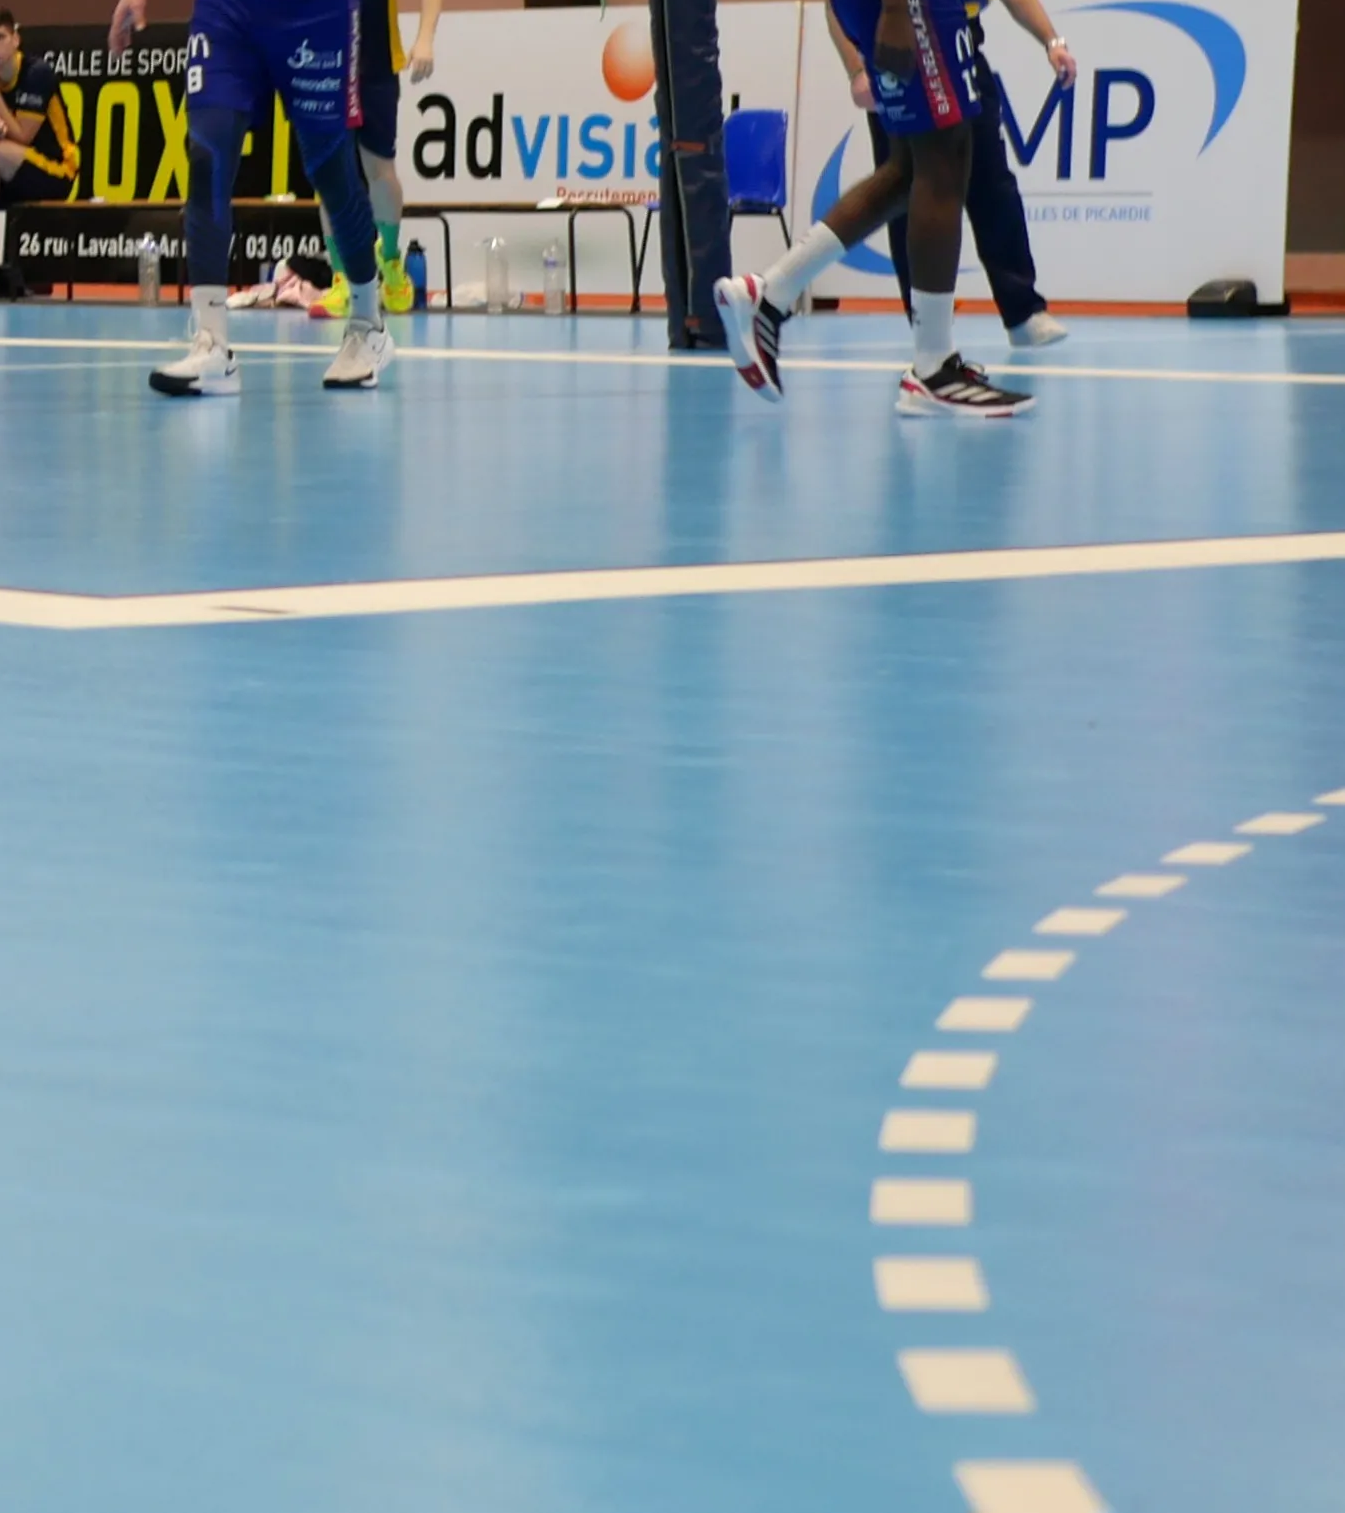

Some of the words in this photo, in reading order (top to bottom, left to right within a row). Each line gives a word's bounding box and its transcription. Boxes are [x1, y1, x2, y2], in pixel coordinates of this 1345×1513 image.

[136, 47, 189, 76] SPOR
[1062, 205, 1079, 222] DE
[1085, 204, 1153, 223] PICARDIE
[18, 231, 41, 257] 26
[245, 233, 268, 260] 03
[271, 233, 294, 260] 60
